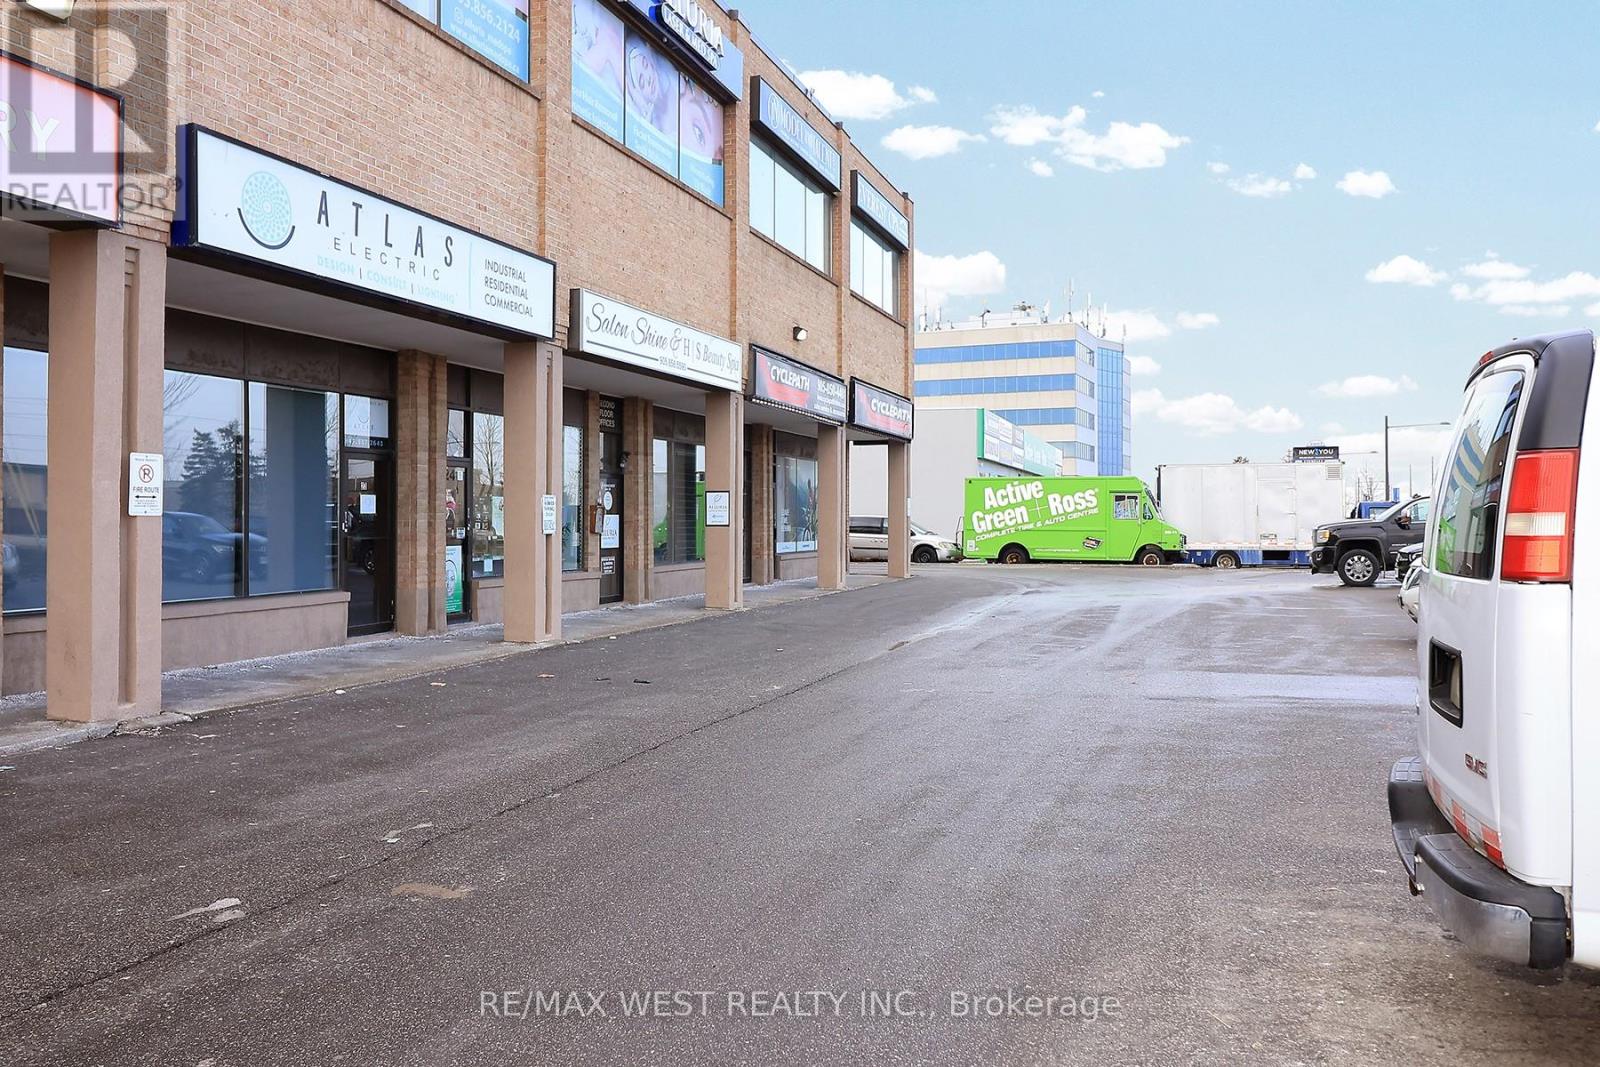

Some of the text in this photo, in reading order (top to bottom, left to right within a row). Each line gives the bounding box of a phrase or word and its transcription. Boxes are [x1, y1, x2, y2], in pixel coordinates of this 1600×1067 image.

[316, 190, 453, 268] ATLAS
[317, 256, 355, 274] DESIGN
[333, 237, 440, 281] ELECTRIC
[484, 259, 527, 283] INDUSTRIAL
[484, 275, 528, 300] RESIDENTIAL
[484, 293, 534, 318] COMMERCIAL
[586, 302, 629, 339] Salon
[631, 317, 668, 350] Shine
[669, 328, 683, 359] &
[702, 345, 726, 373] Beauty
[726, 352, 740, 376] Spa
[770, 366, 810, 392] CYCLEPATH
[871, 398, 912, 423] CYCLEPATH
[132, 486, 160, 494] FIRE ROUTE
[984, 480, 1044, 510] Active
[972, 505, 1029, 534] Green
[1048, 488, 1099, 516] Ross
[975, 527, 1016, 542] COMPLETE
[1017, 522, 1035, 532] TIRE
[1043, 515, 1066, 526] AUTO
[1067, 507, 1099, 520] CENTRE
